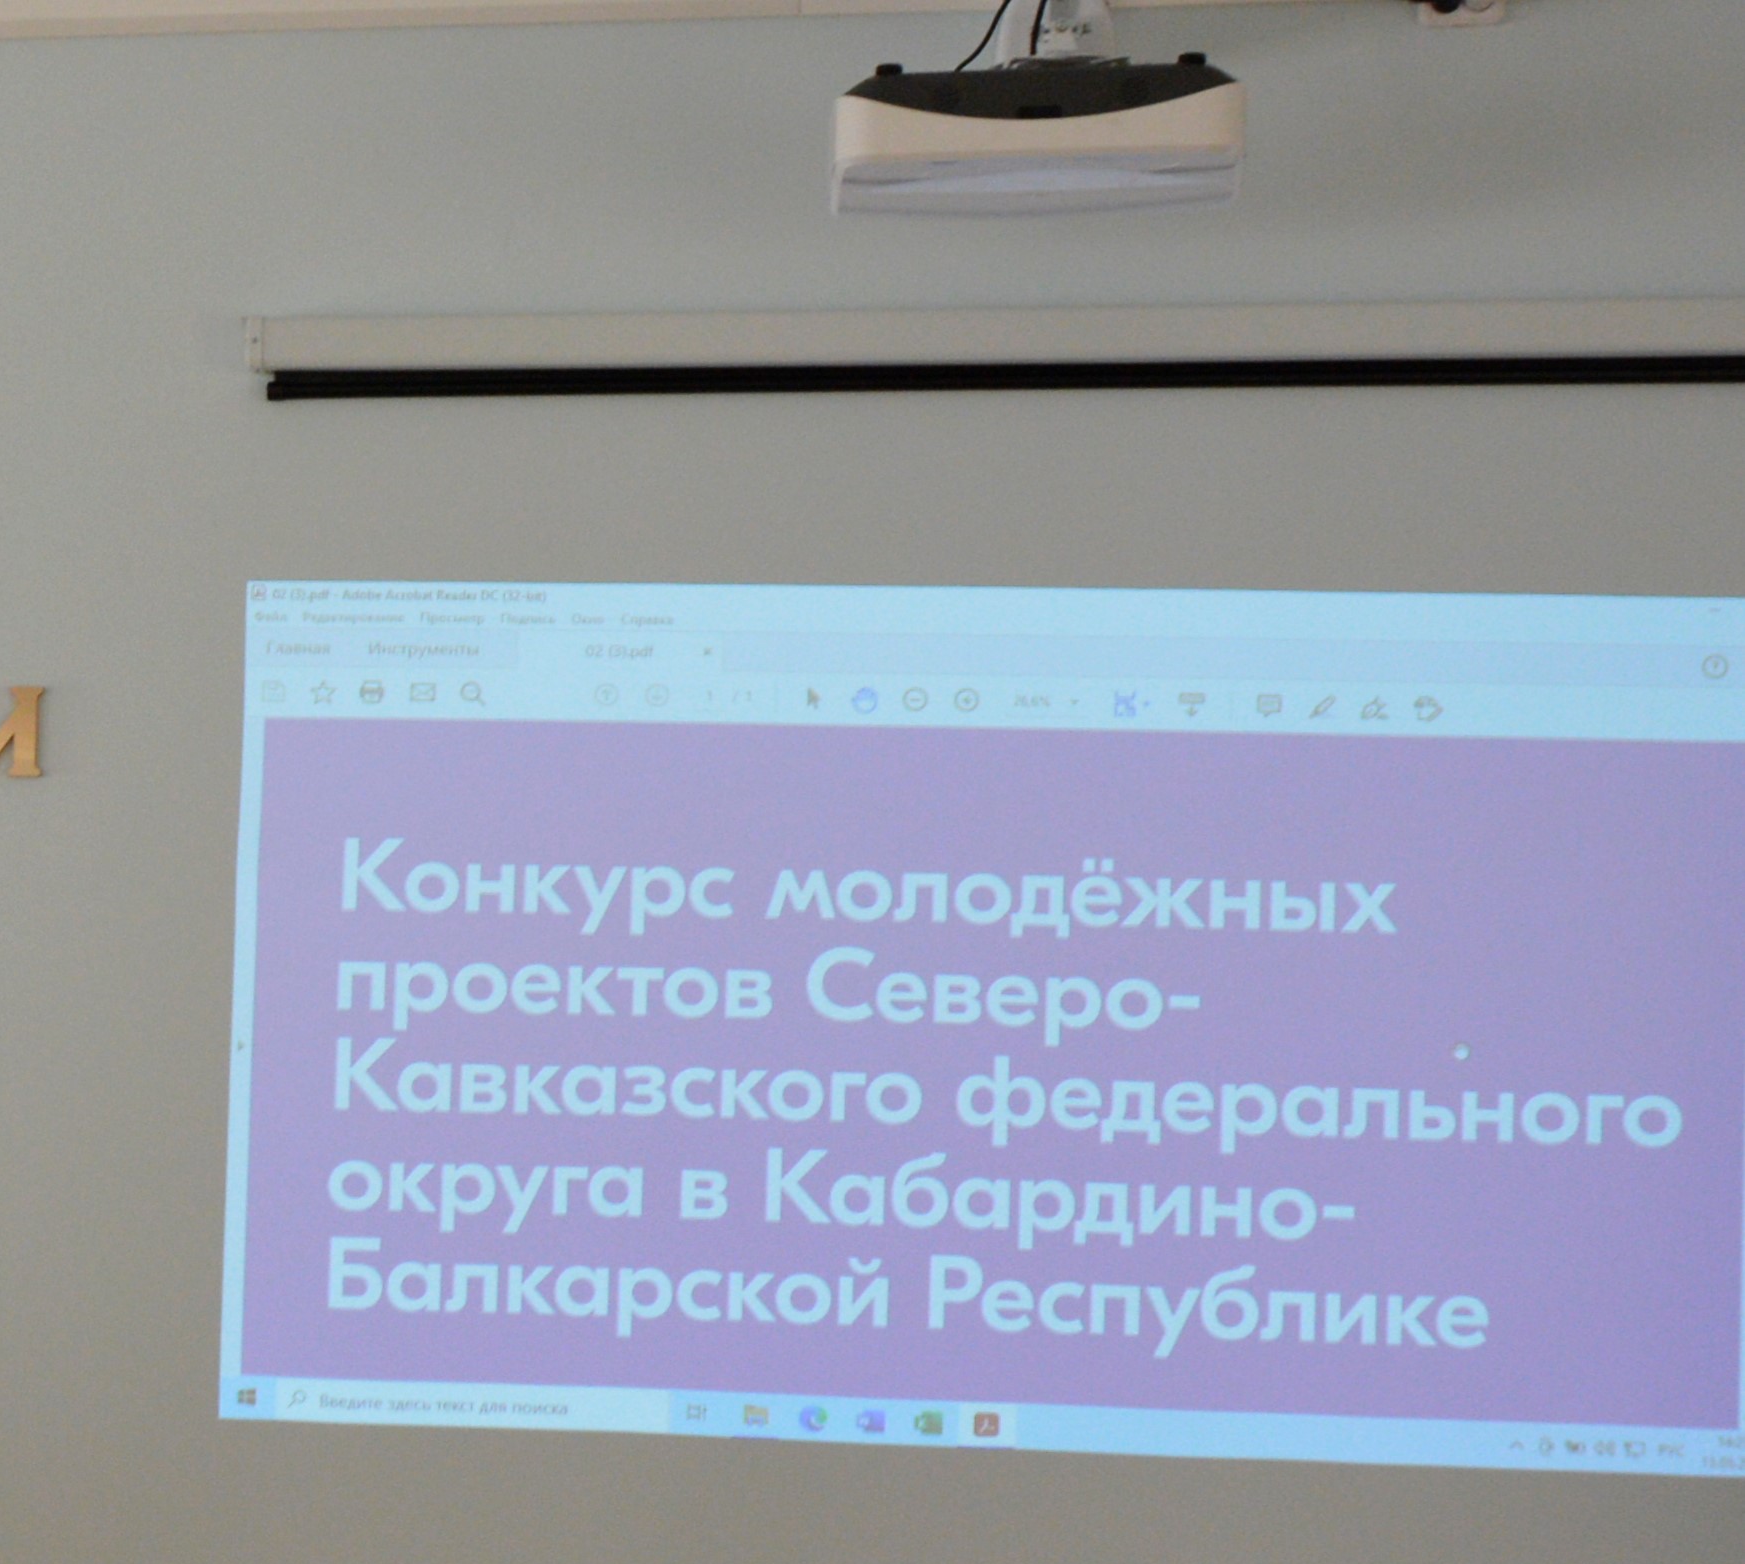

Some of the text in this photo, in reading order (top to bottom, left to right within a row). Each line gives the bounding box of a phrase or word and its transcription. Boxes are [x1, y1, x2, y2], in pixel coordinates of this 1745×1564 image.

[368, 640, 481, 660] Инструменты
[340, 836, 1398, 938] Конкурс молодёжных
[336, 945, 1202, 1047] проектов Северо-
[332, 1036, 1685, 1155] Кавказского федерального
[326, 1146, 1357, 1251] округа в Кабардино-
[326, 1235, 1490, 1360] Балкарской Республике
[512, 1402, 569, 1416] поиска
